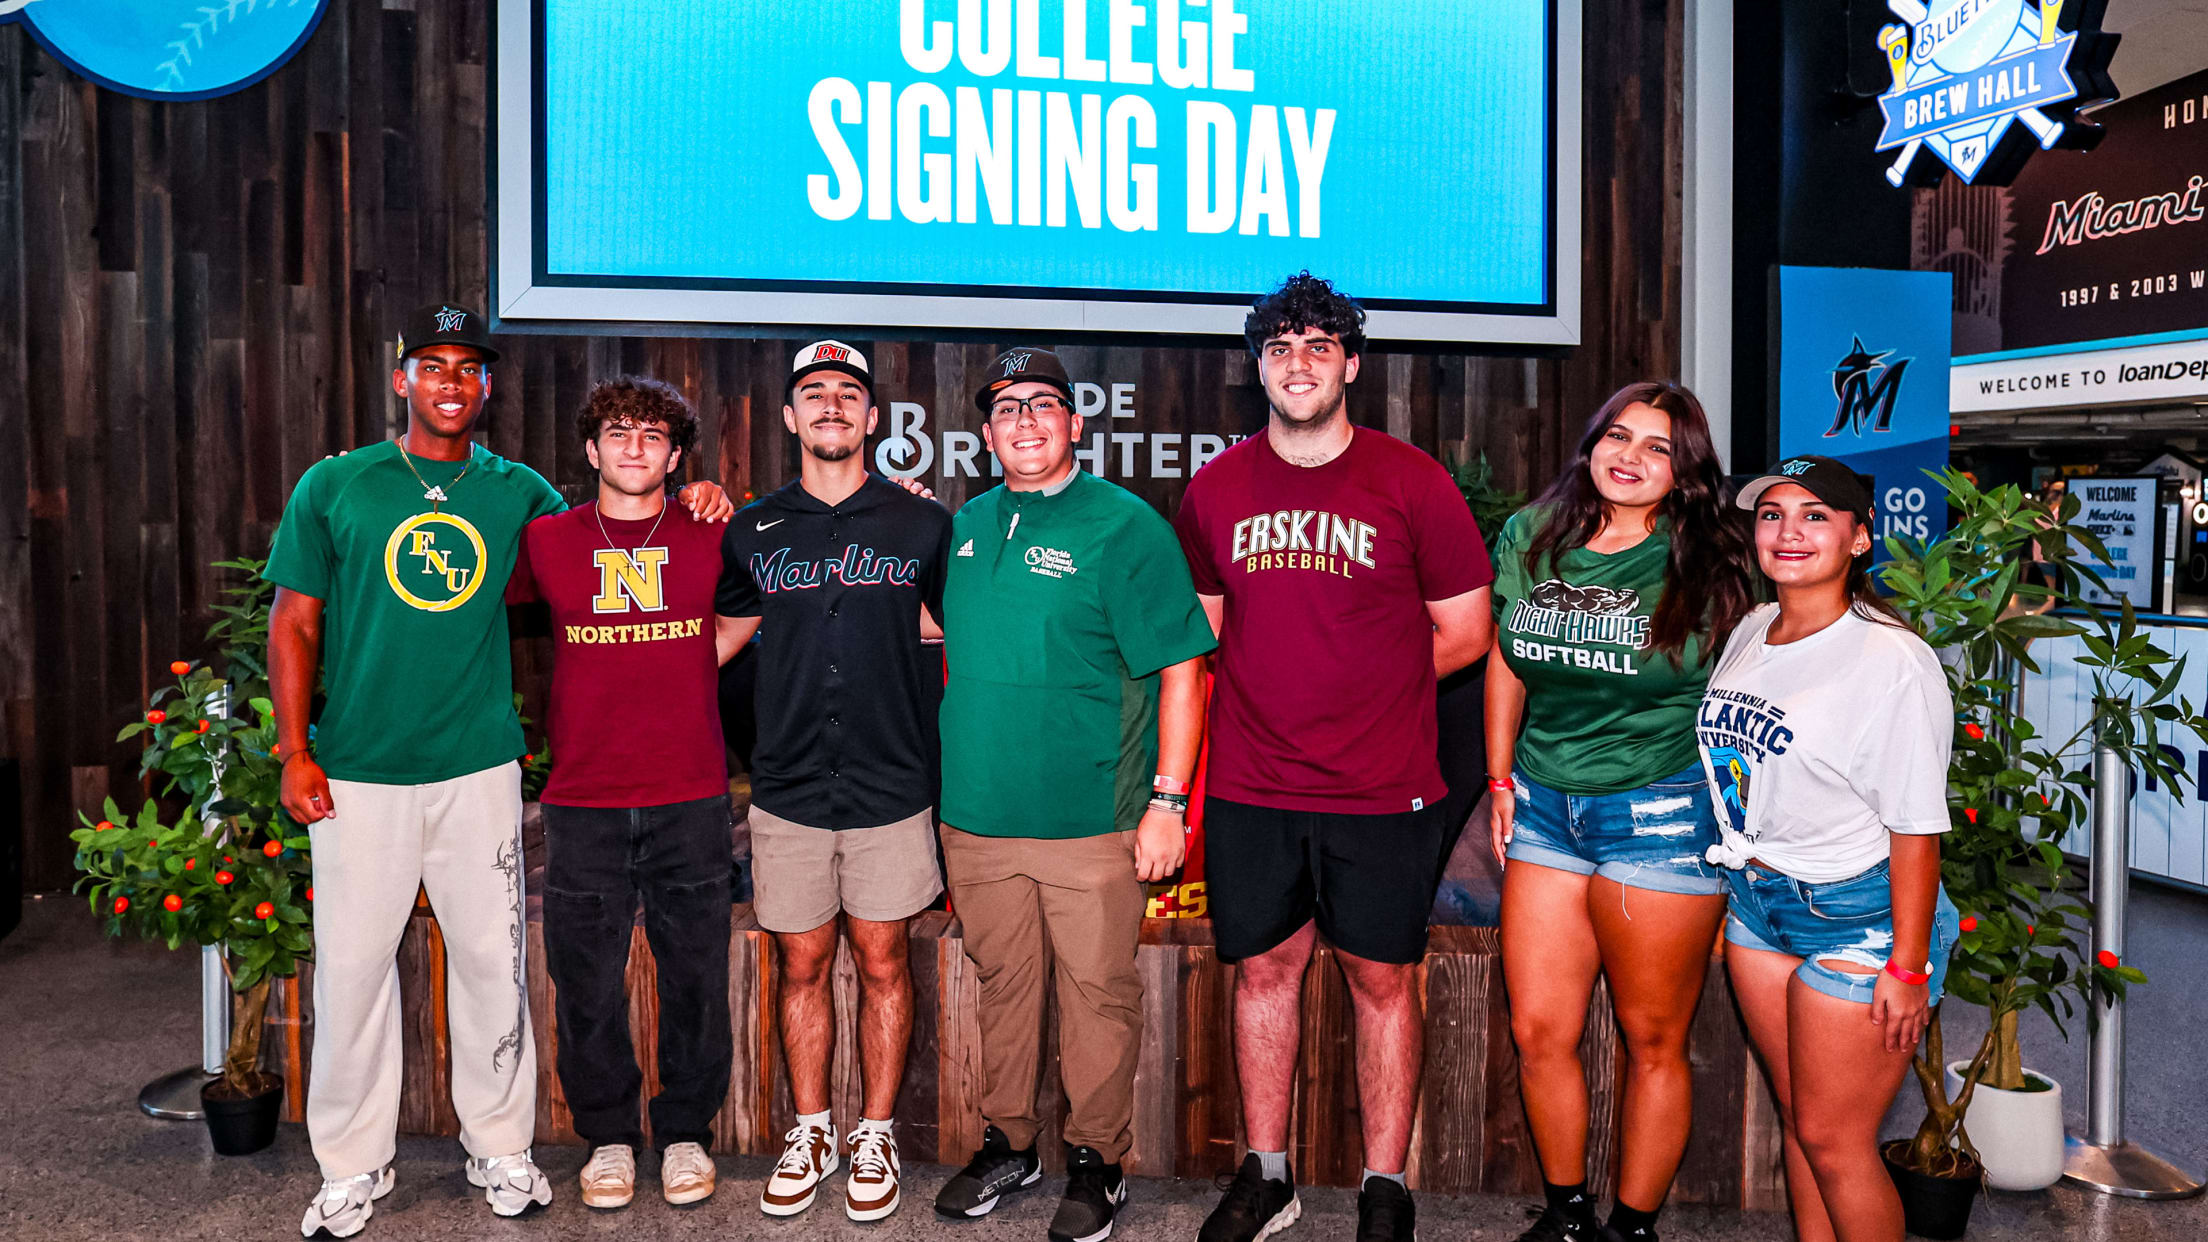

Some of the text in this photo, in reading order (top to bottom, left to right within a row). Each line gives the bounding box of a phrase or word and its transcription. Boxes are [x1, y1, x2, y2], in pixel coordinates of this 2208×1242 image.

[900, 0, 1254, 91] COLLEGE
[1916, 0, 1969, 59] BLUE
[1904, 61, 2041, 129] BREW HALL
[807, 77, 1337, 238] SIGNING DAY
[2035, 176, 2205, 255] Miami
[2061, 286, 2098, 307] 1997
[2110, 283, 2119, 300] &
[2131, 274, 2177, 297] 2003
[812, 344, 850, 362] DU
[1980, 373, 2070, 394] WELCOME
[2081, 370, 2106, 386] TO
[1074, 382, 1136, 418] DE
[875, 401, 1226, 480] BRIHTER
[1884, 487, 1926, 513] GO
[2086, 486, 2137, 502] WELCOME
[2087, 508, 2135, 521] Marlins
[1046, 548, 1071, 558] Florida
[1232, 510, 1377, 570] ERSKINE
[408, 530, 470, 593] FNU
[751, 544, 919, 594] Marlins
[1030, 566, 1063, 579] BASEBALL
[1041, 560, 1078, 575] University
[1045, 554, 1073, 566] National
[1247, 552, 1353, 579] BASEBALL
[592, 547, 669, 614] N
[565, 618, 703, 645] NORTHERN
[1512, 638, 1638, 676] SOFTBALL
[1709, 688, 1767, 710] MILLENNIA
[1697, 700, 1794, 756] LANTIC
